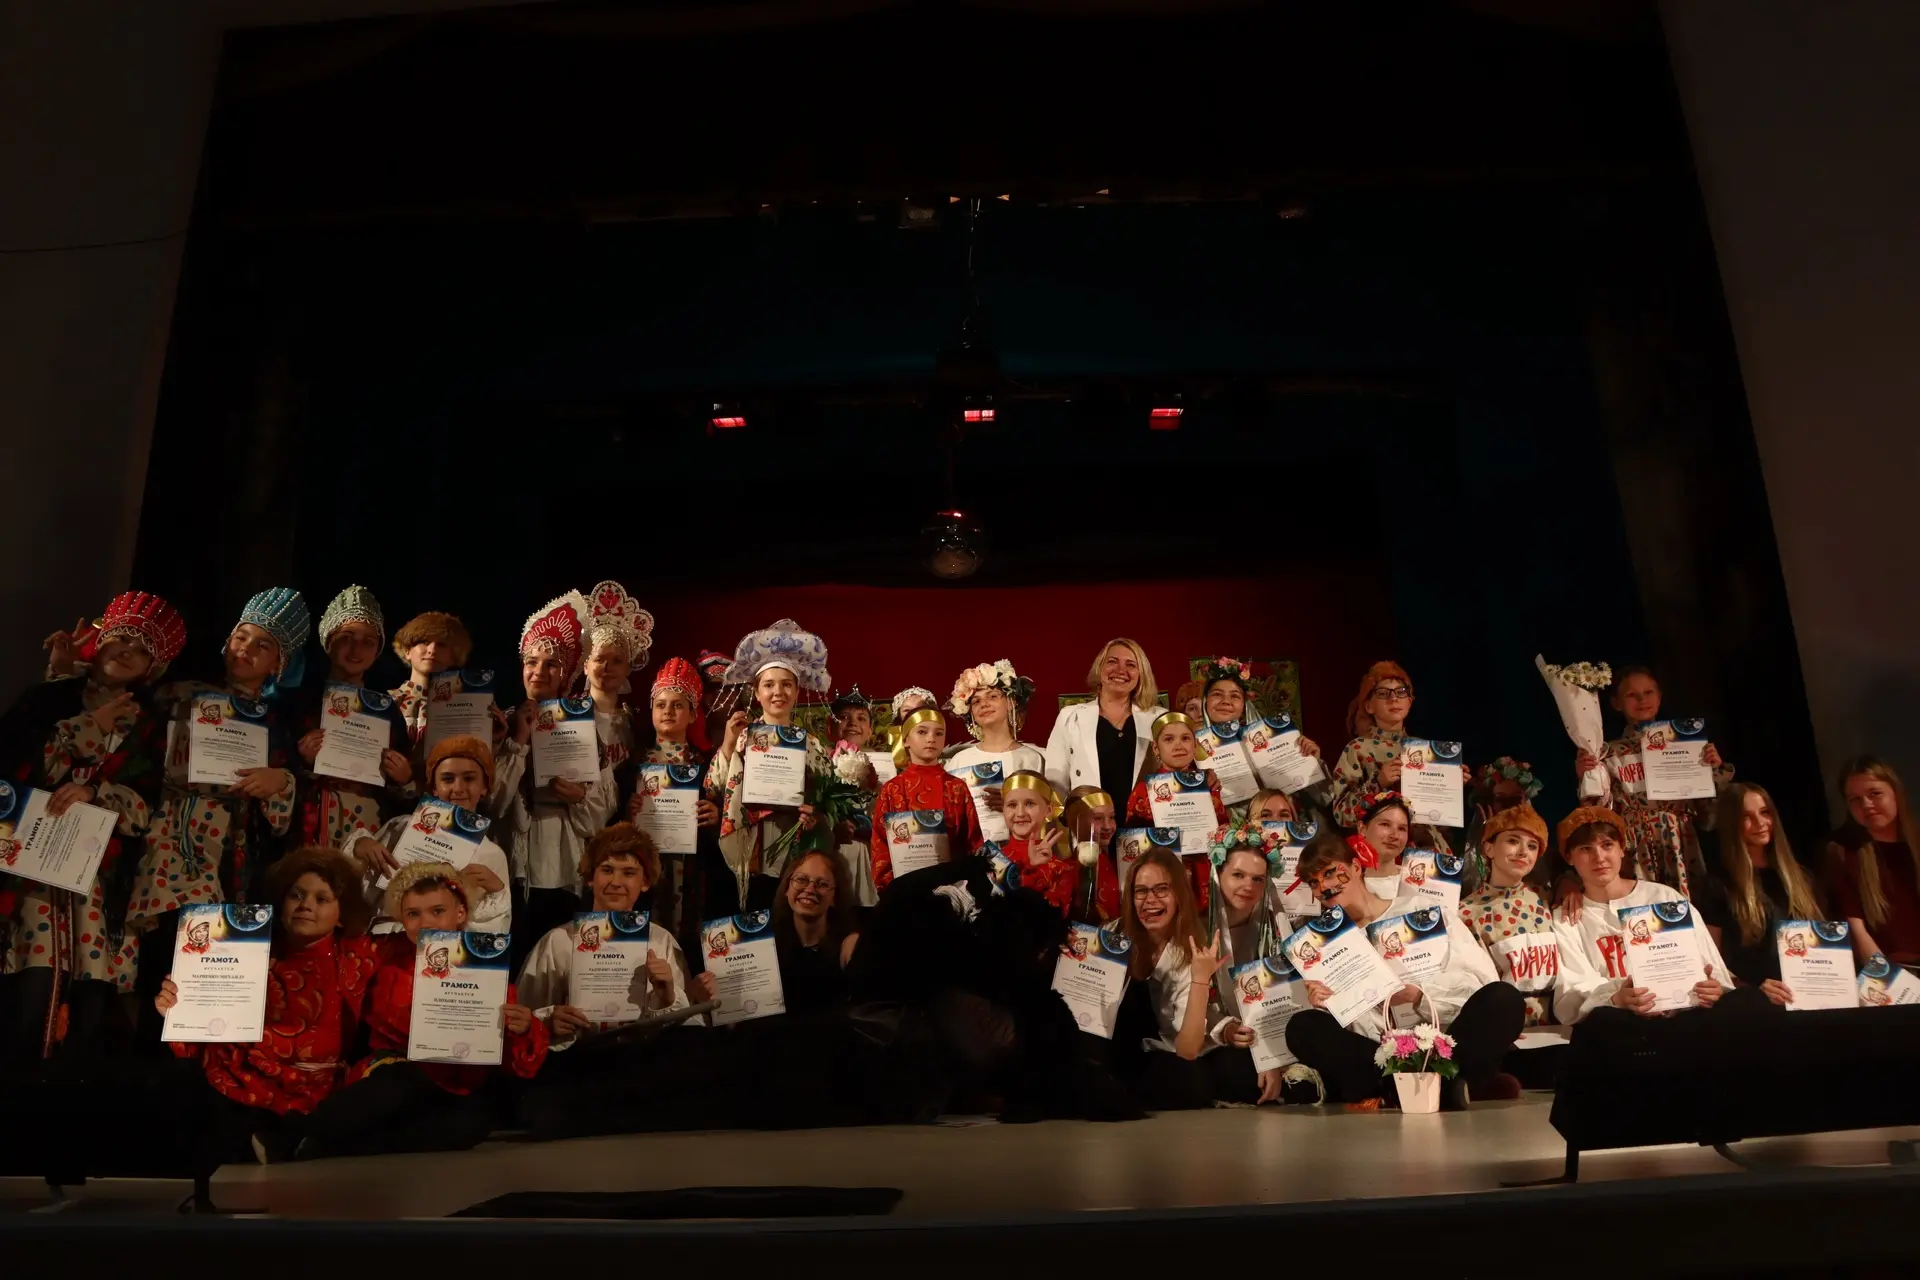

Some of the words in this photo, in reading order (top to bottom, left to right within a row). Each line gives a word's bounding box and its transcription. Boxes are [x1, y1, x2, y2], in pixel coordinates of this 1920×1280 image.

[343, 720, 371, 730] ГРАМОТА
[215, 727, 247, 736] ГРАМОТА
[1267, 742, 1289, 753] ГРАМОТА
[1212, 752, 1236, 761] ГРАМОТА
[24, 817, 44, 851] ГРАМОТА
[424, 836, 453, 850] ГРАМОТА
[1418, 888, 1444, 897] ГРАМОТА
[1648, 943, 1678, 951] ГРАМОТА
[201, 956, 240, 964] ГРАМОТА
[725, 953, 755, 963] ГРАМОТА
[1321, 947, 1349, 967] ГРАМОТА
[1402, 952, 1432, 964] ГРАМОТА
[1078, 963, 1106, 976] ГРАМОТА
[441, 981, 479, 989] ГРАМОТА
[1261, 995, 1291, 1007] ГРАМОТА
